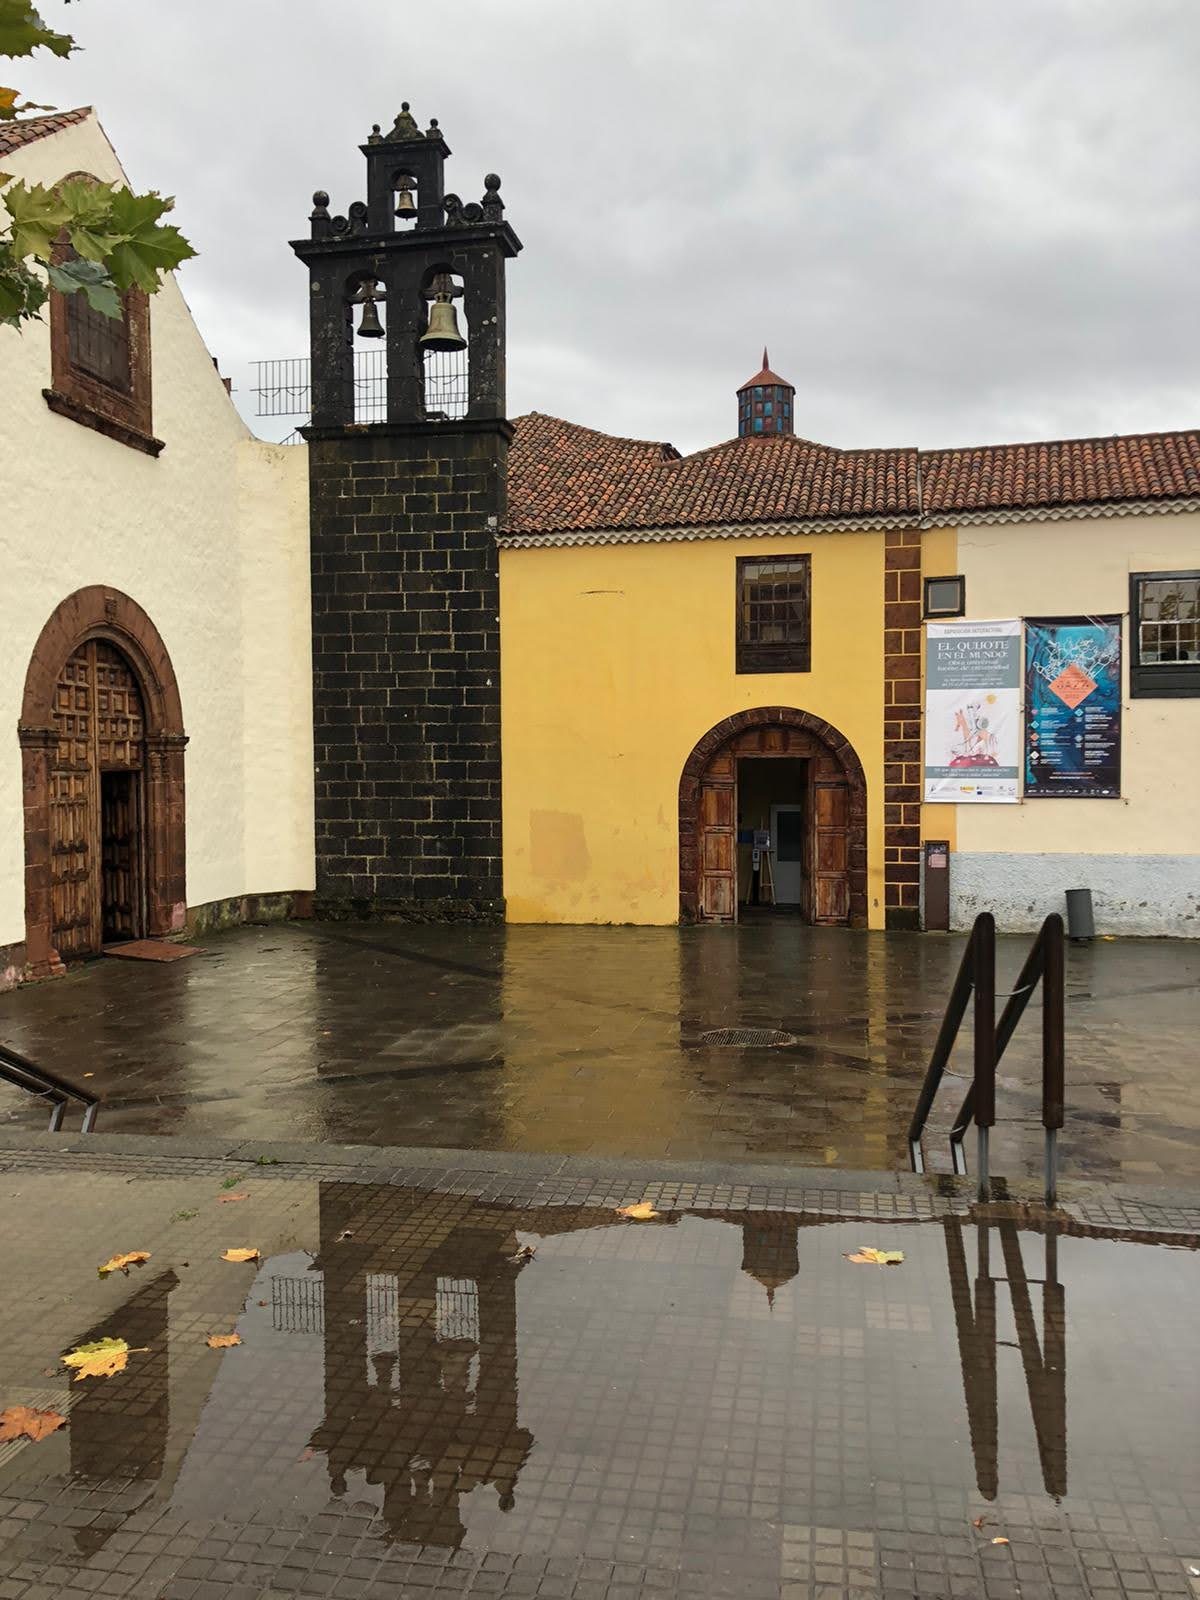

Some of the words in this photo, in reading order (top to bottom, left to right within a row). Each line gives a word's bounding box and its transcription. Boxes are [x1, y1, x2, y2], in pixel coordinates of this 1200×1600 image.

[937, 642, 954, 651] EL
[957, 641, 1009, 652] QUIJOTE
[937, 652, 952, 660] EN
[954, 651, 966, 659] EL
